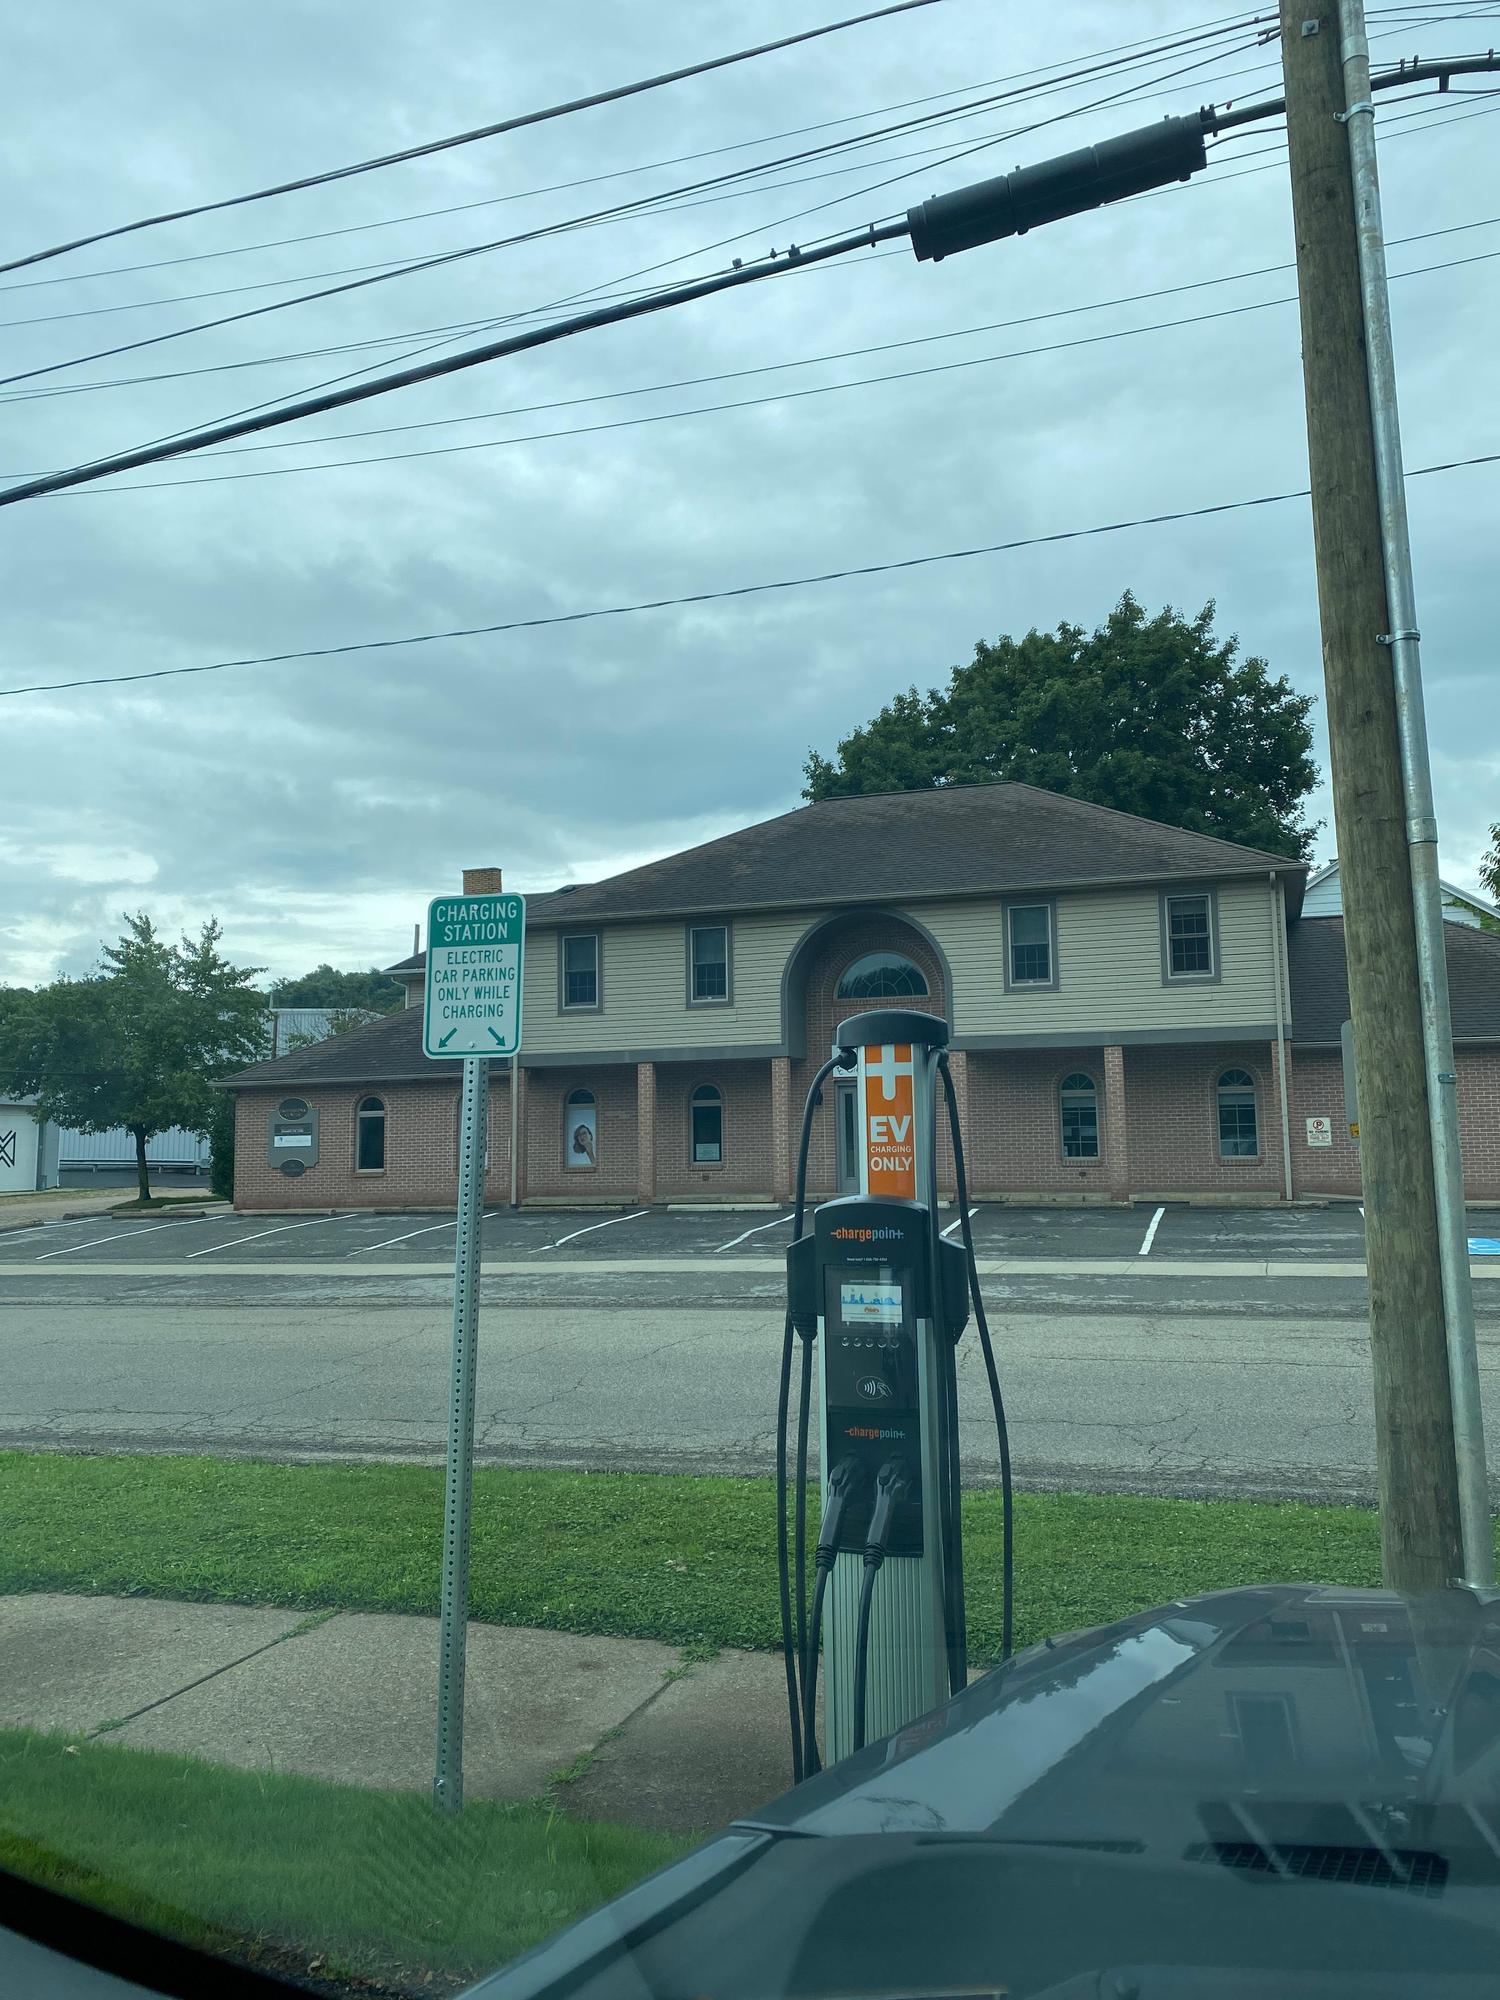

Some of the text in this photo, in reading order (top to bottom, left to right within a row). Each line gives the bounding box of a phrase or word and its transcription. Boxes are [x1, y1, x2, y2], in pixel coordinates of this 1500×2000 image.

[437, 902, 517, 922] CHARGING
[444, 922, 508, 941] STATION
[447, 949, 503, 965] ELECTRIC
[434, 967, 515, 983] CAR PARKING
[438, 985, 510, 1001] ONLY WHILE
[442, 1004, 504, 1019] CHARGING
[870, 1116, 911, 1142] EV
[870, 1156, 912, 1172] ONLY
